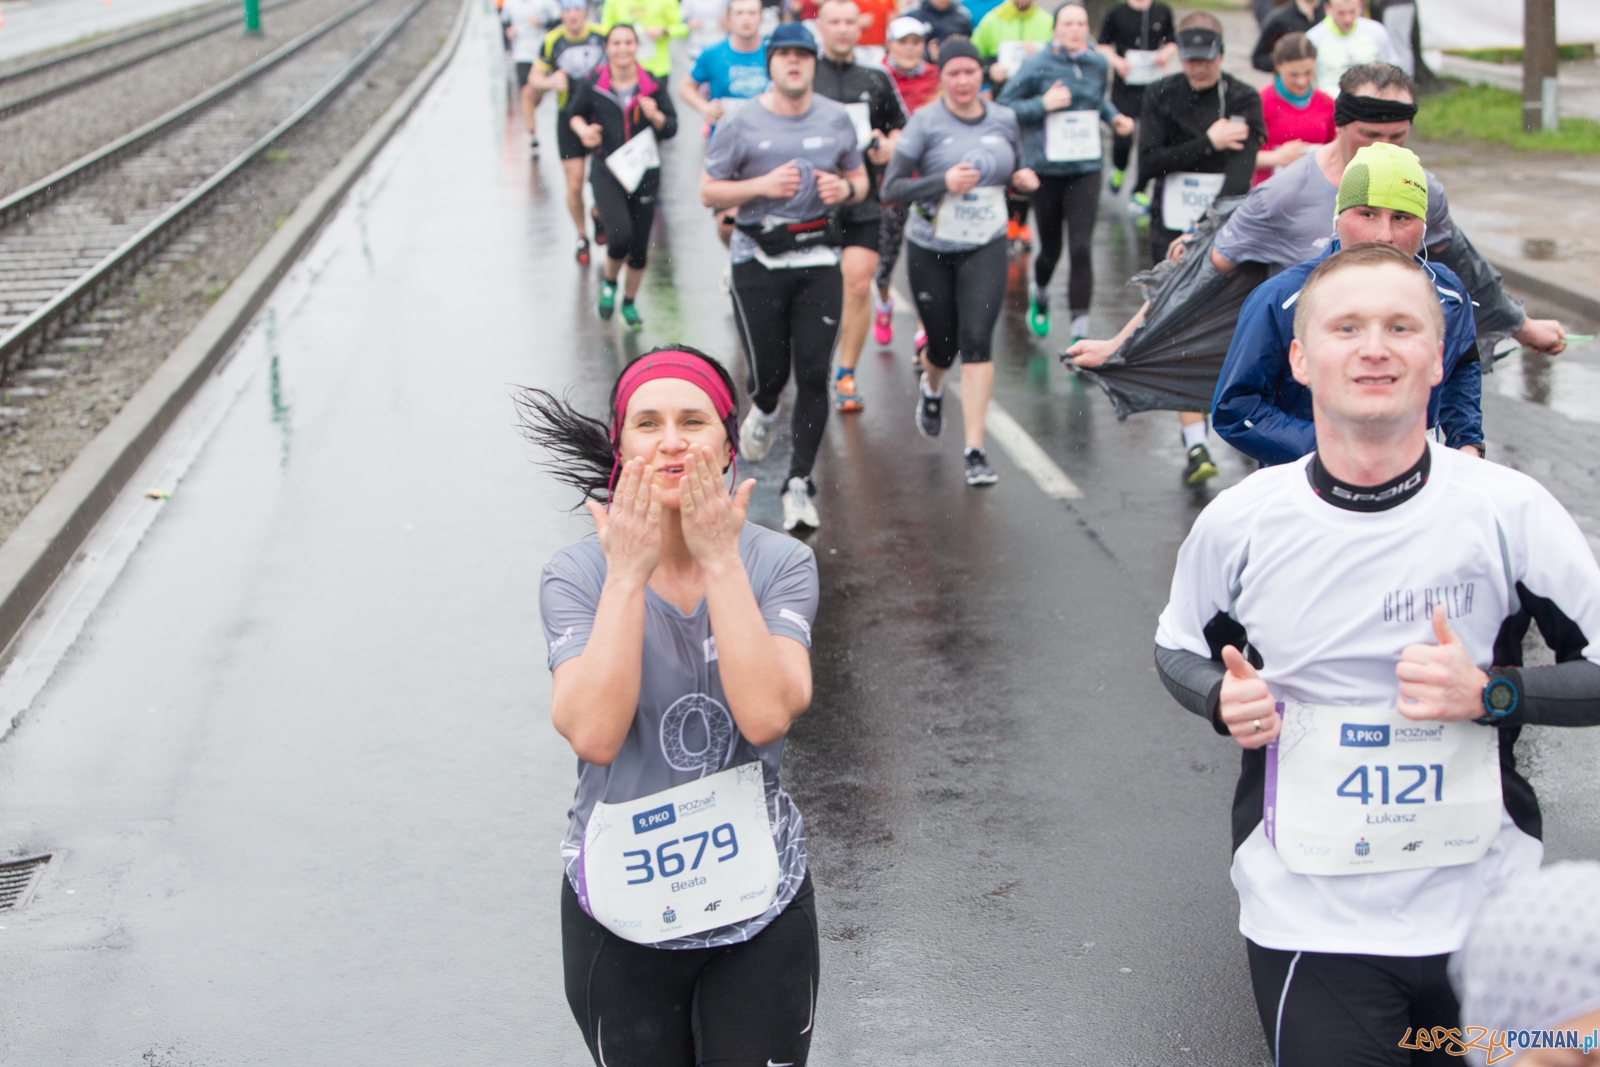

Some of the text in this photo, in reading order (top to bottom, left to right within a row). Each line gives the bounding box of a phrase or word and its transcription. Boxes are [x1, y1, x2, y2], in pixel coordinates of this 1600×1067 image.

[1384, 588, 1415, 622] BEA
[1336, 763, 1444, 806] 4121
[1366, 813, 1417, 825] Łukasz
[622, 822, 739, 885] 3679
[671, 876, 707, 893] Beata
